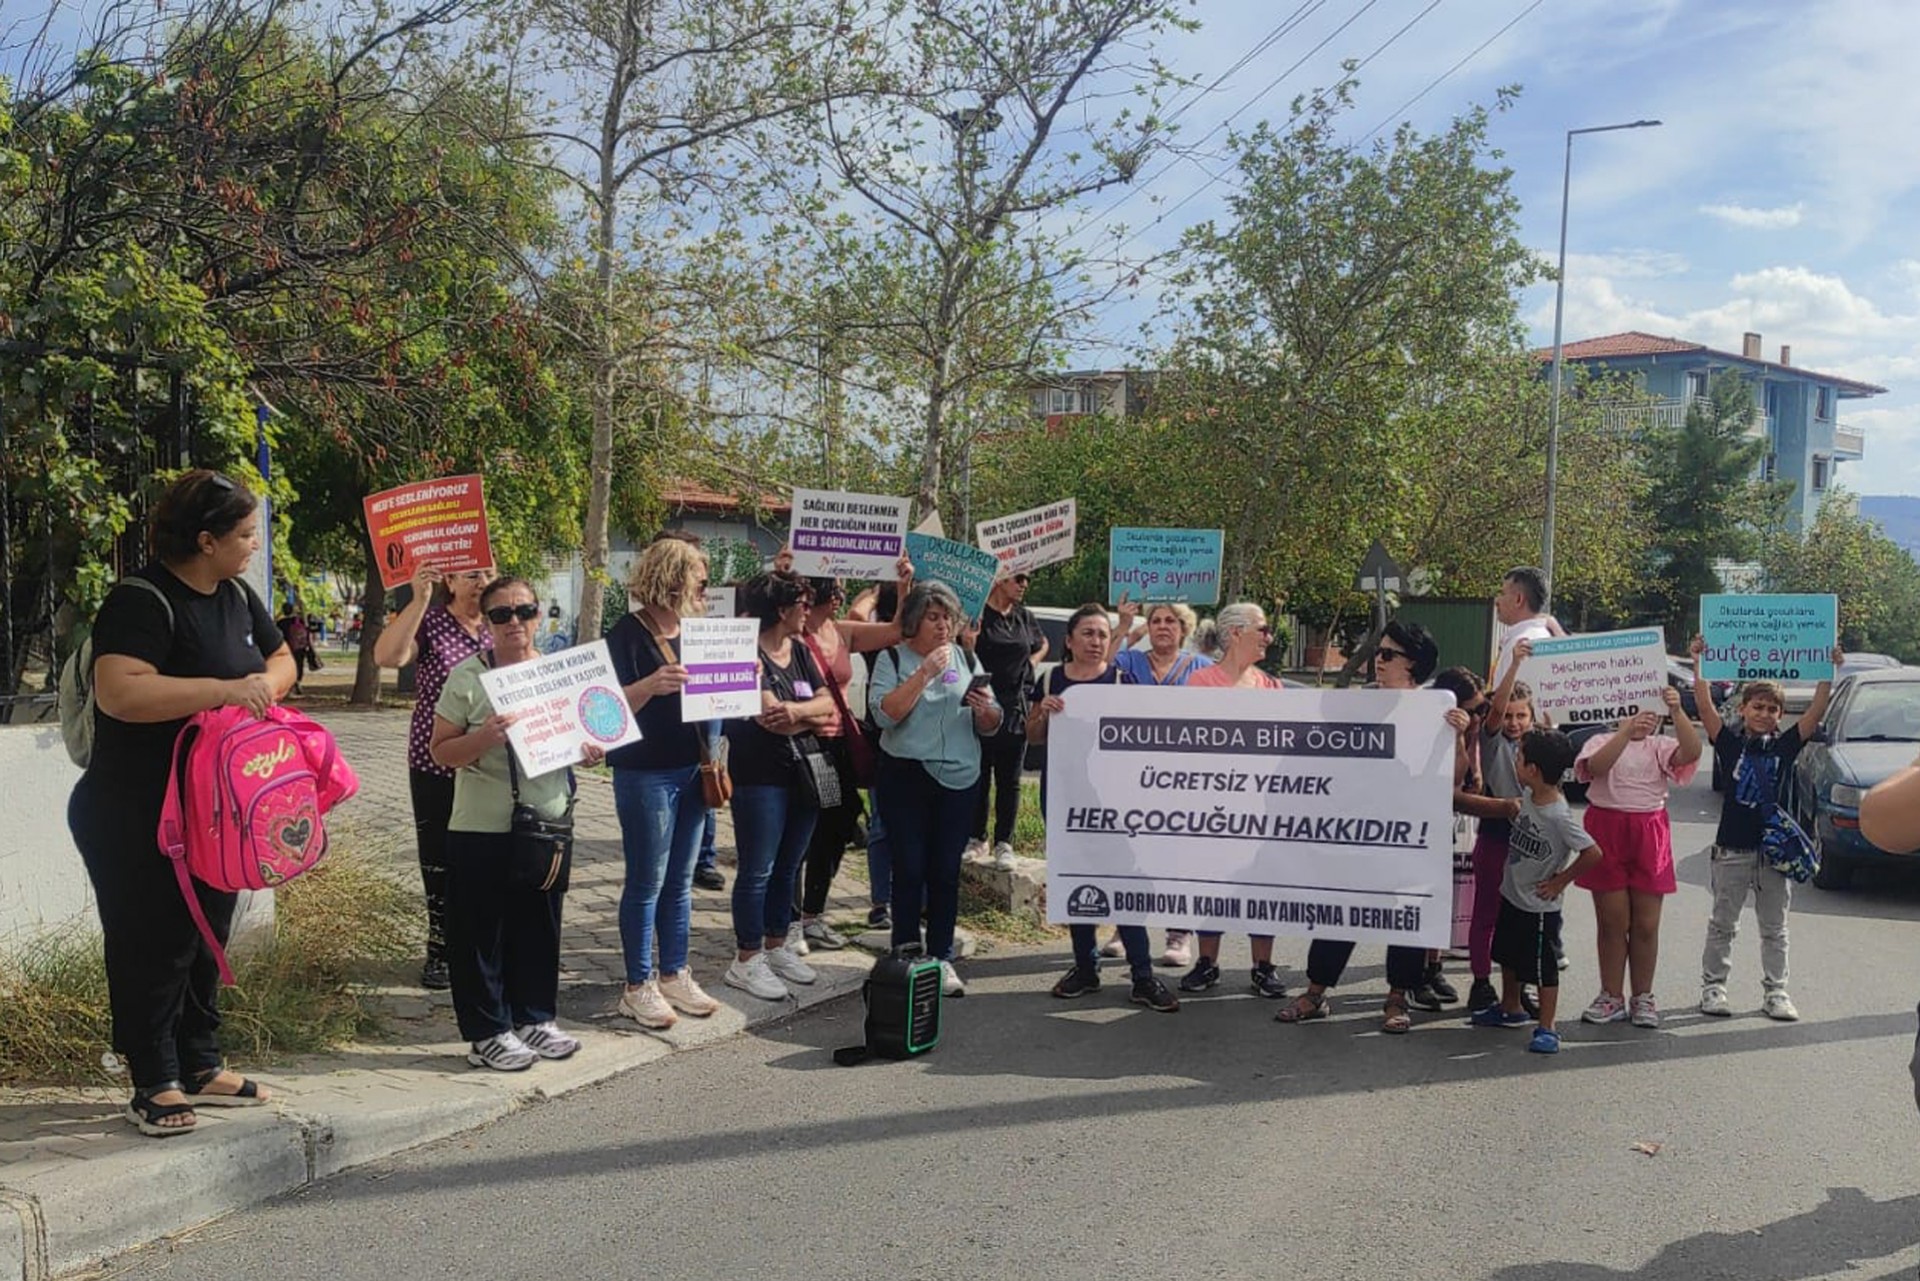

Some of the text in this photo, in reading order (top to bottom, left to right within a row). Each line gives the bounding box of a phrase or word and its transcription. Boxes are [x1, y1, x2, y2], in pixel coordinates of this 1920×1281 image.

[803, 498, 899, 517] SAĞLIKLI BESLENMEK
[800, 516, 897, 534] HER ÇOCUĞUN HAKKI
[982, 527, 998, 538] HER
[999, 524, 1006, 533] 2
[820, 536, 882, 552] SORUMLULUK
[990, 532, 1031, 549] OKULLARDA
[927, 536, 998, 570] OKULLARDA
[1164, 569, 1216, 588] ayırın!
[1720, 605, 1815, 618] Okullarda çocuklara
[1748, 621, 1759, 629] ve
[1796, 621, 1826, 631] yemek
[536, 661, 565, 681] ÇOCUK
[565, 650, 597, 667] KRONİK
[1551, 654, 1643, 675] Beslenme hakkı
[1767, 645, 1830, 667] ayırın!
[1540, 670, 1658, 692] her öğrenciye devlet
[1737, 668, 1800, 679] BORKAD
[498, 664, 608, 706] YETERSİZ BESLENME YAŞIYOR
[1537, 693, 1600, 709] tarafından
[1569, 704, 1640, 722] BORKAD
[1100, 723, 1386, 752] OKULLARDA BİR ÖGÜN
[1140, 766, 1333, 796] ÜCRETSİZ YEMEK
[1066, 805, 1430, 845] HER ÇOCUĞUN HAKKIDIR !
[1113, 890, 1421, 932] BORNOVA KADIN DAYANIŞMA DERNEĞİ
